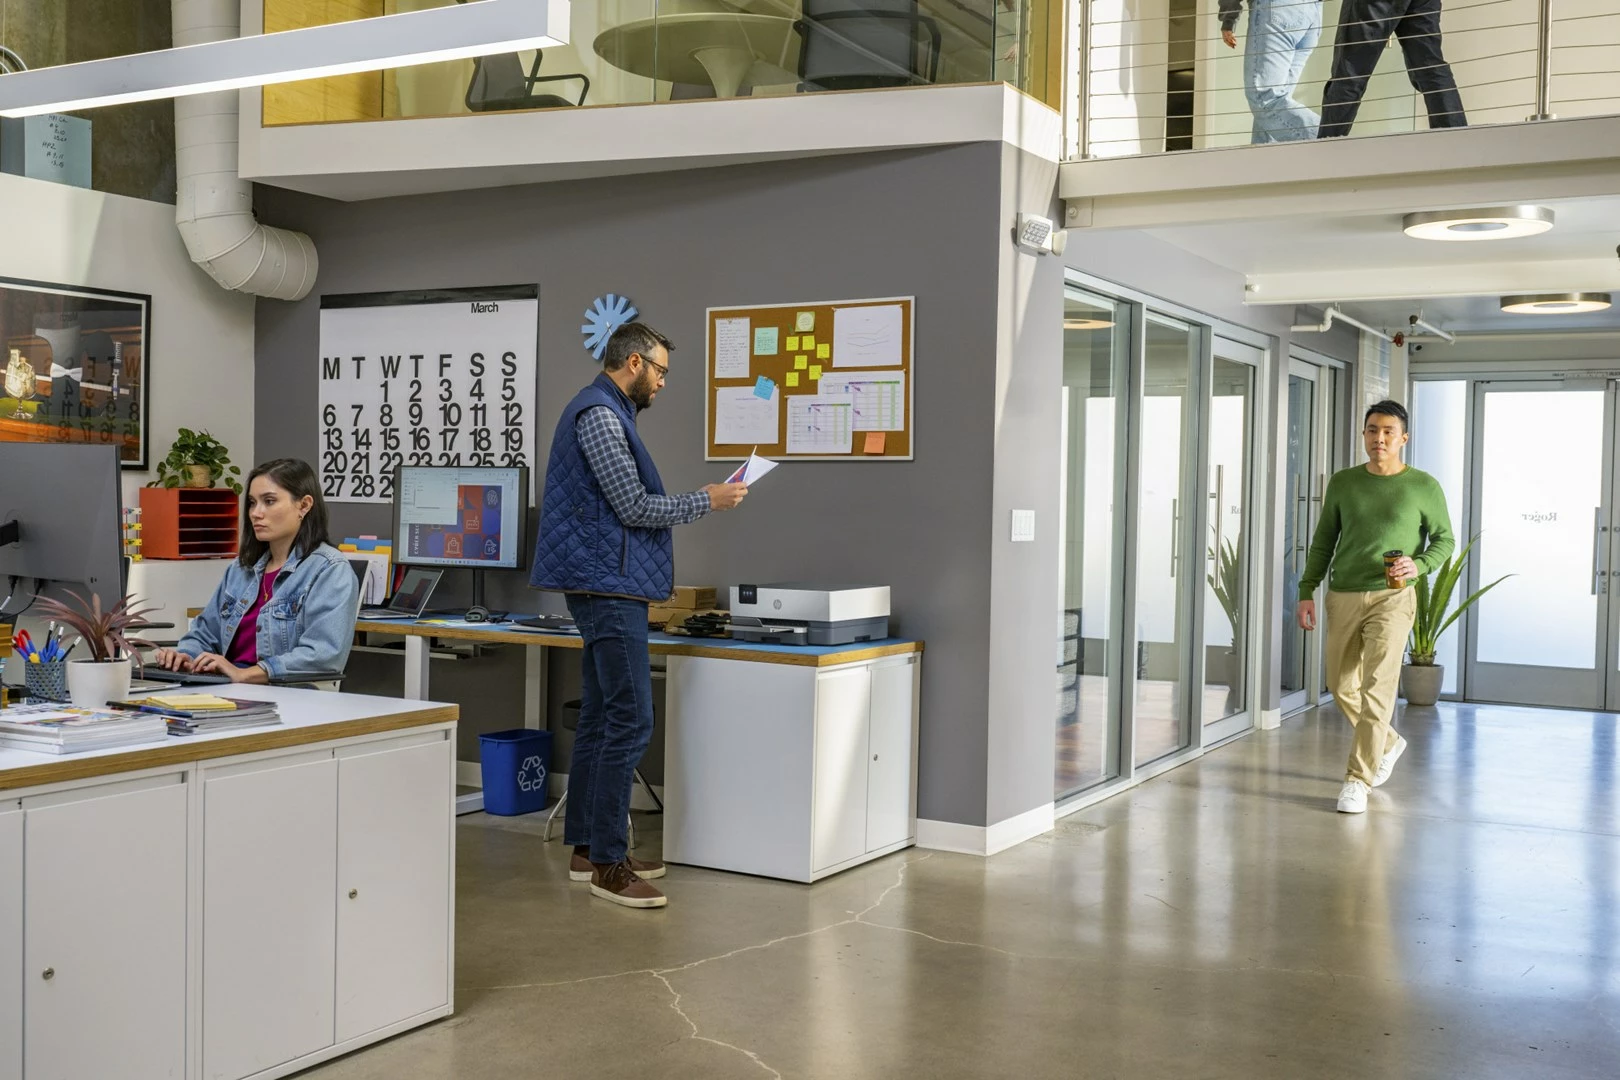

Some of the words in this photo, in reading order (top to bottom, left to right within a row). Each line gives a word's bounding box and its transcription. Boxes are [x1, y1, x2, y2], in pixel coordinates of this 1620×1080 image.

[471, 302, 498, 313] March
[323, 357, 340, 379] M
[352, 357, 365, 379] T
[381, 356, 401, 378] W
[410, 355, 424, 378] T
[439, 354, 452, 377] F
[470, 353, 484, 377] S
[502, 352, 516, 376] S
[380, 381, 388, 402] 1
[409, 380, 422, 402] 2
[439, 379, 452, 402] 3
[470, 379, 484, 401] 4
[502, 378, 515, 401] 5
[323, 404, 336, 427] 6
[352, 405, 363, 426] 7
[380, 404, 393, 426] 8
[409, 403, 422, 426] 9
[439, 403, 461, 426] 10
[470, 404, 486, 426] 11
[501, 403, 522, 426] 12
[323, 428, 343, 450] 13
[351, 428, 372, 450] 14
[380, 428, 400, 450] 15
[409, 427, 430, 450] 16
[439, 428, 459, 451] 17
[469, 428, 491, 451] 18
[501, 428, 523, 451] 19
[323, 451, 347, 473] 20
[351, 452, 369, 474] 21
[379, 452, 403, 474] 22
[409, 452, 432, 466] 23
[439, 452, 461, 466] 24
[469, 452, 495, 467] 25
[501, 452, 526, 467] 26
[323, 475, 345, 497] 27
[351, 475, 375, 497] 28
